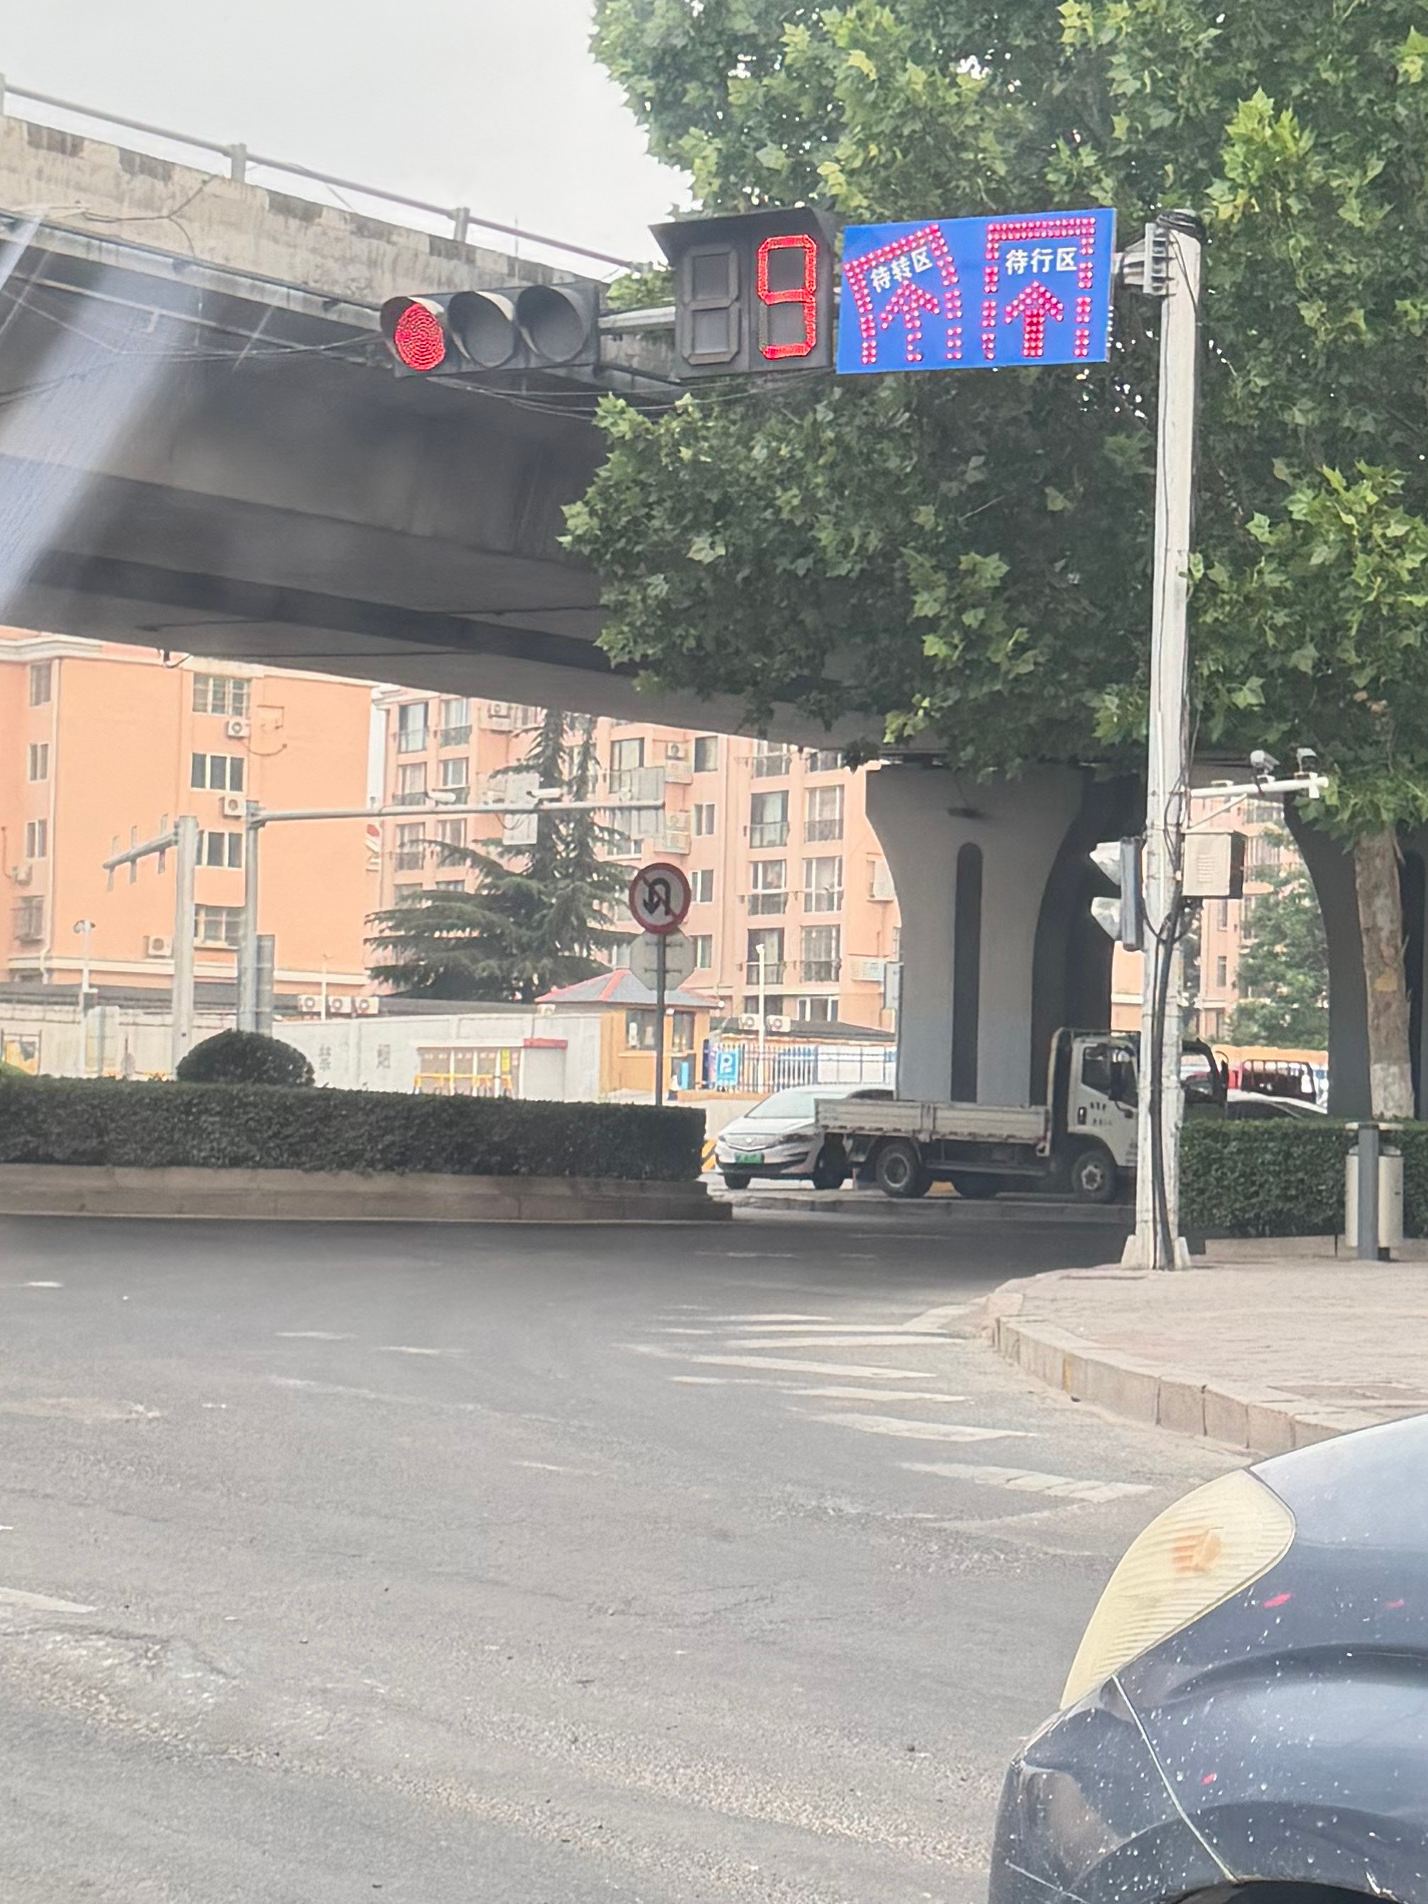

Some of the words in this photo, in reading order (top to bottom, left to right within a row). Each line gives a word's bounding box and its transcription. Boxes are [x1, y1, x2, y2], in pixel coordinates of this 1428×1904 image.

[870, 247, 933, 292] 待转区
[1005, 247, 1077, 274] 待行区
[757, 234, 818, 360] 9
